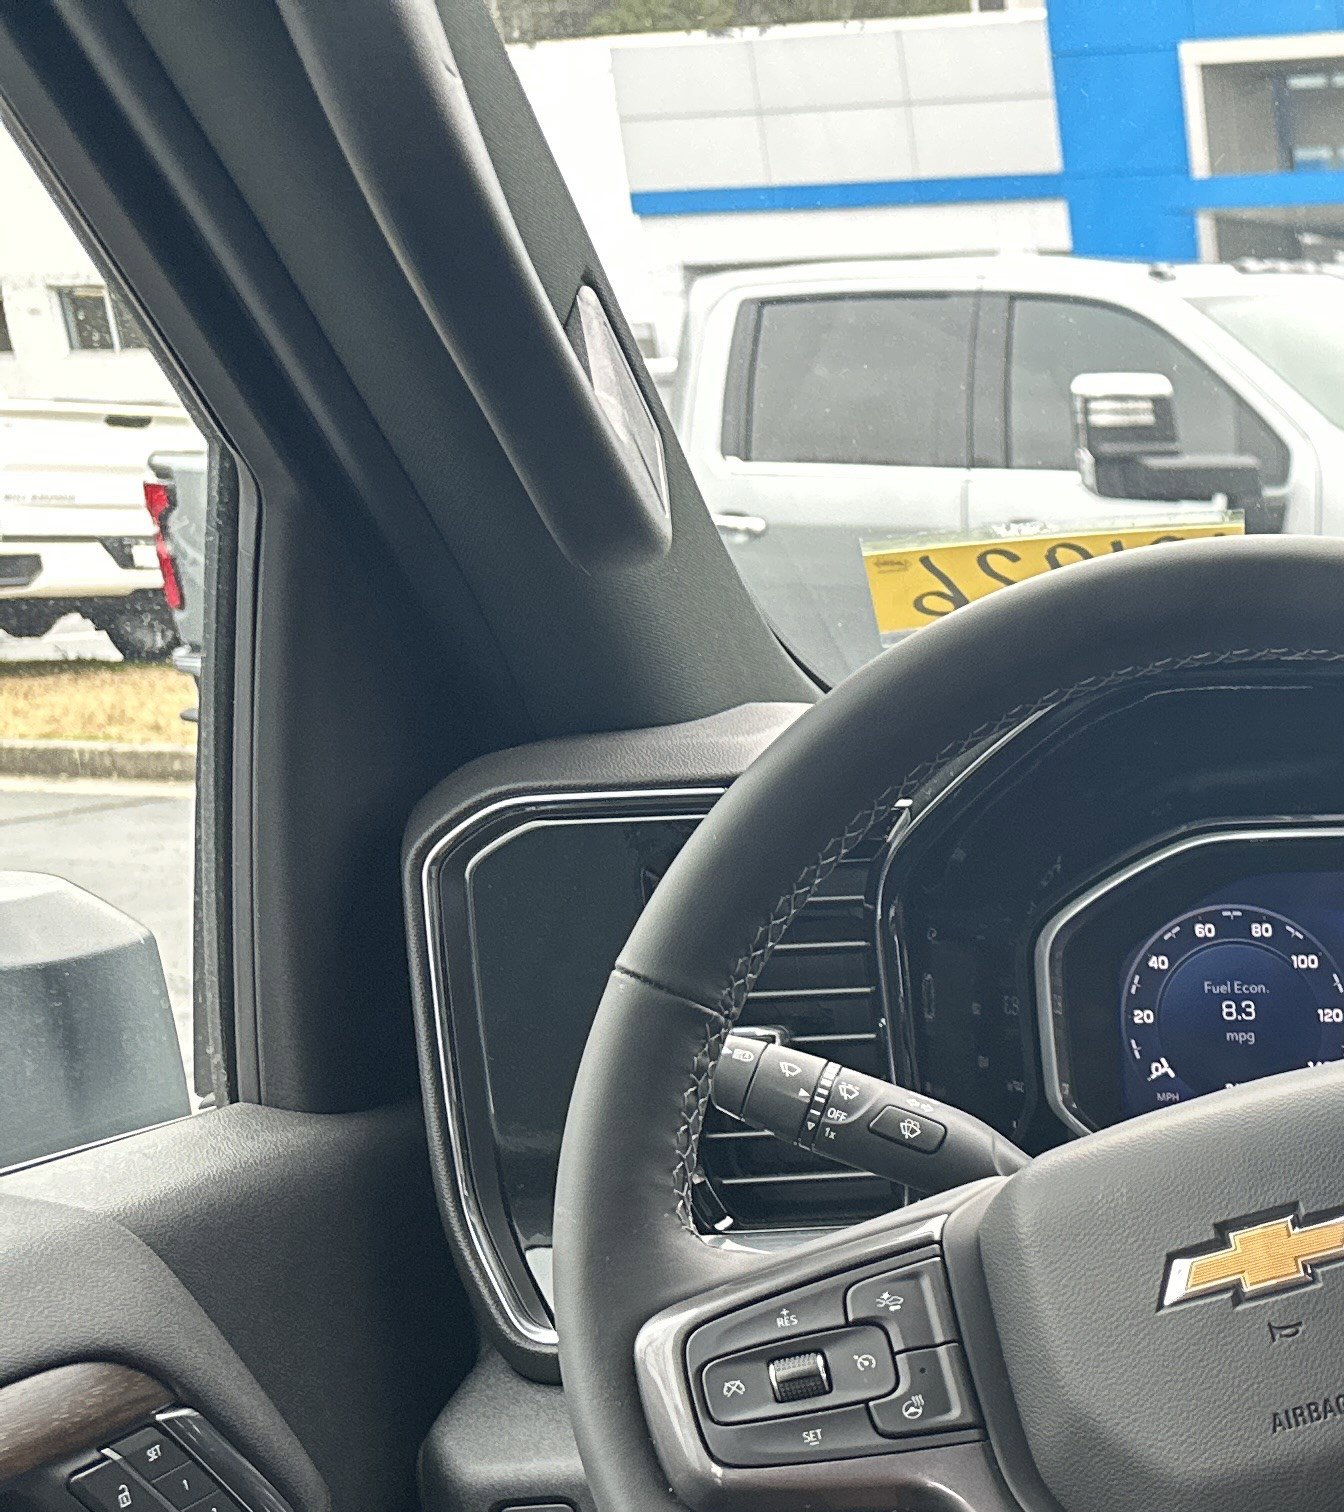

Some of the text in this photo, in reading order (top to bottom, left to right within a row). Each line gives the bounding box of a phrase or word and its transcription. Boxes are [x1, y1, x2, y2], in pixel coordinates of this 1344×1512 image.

[1194, 923, 1216, 938] 60
[1251, 923, 1273, 938] 80
[1148, 955, 1169, 970] 40
[1291, 954, 1319, 969] 100
[1204, 980, 1270, 994] Fuel Econ.
[1133, 1009, 1155, 1024] 20
[1221, 1000, 1256, 1021] 8.3
[1317, 1008, 1344, 1023] 120
[1226, 1030, 1256, 1045] mpg
[1156, 1091, 1180, 1102] MPH
[827, 1106, 848, 1122] OFF
[823, 1127, 837, 1140] 1x
[776, 1313, 799, 1327] RES
[802, 1427, 824, 1443] SET
[146, 1444, 162, 1463] SET
[182, 1479, 190, 1491] 1
